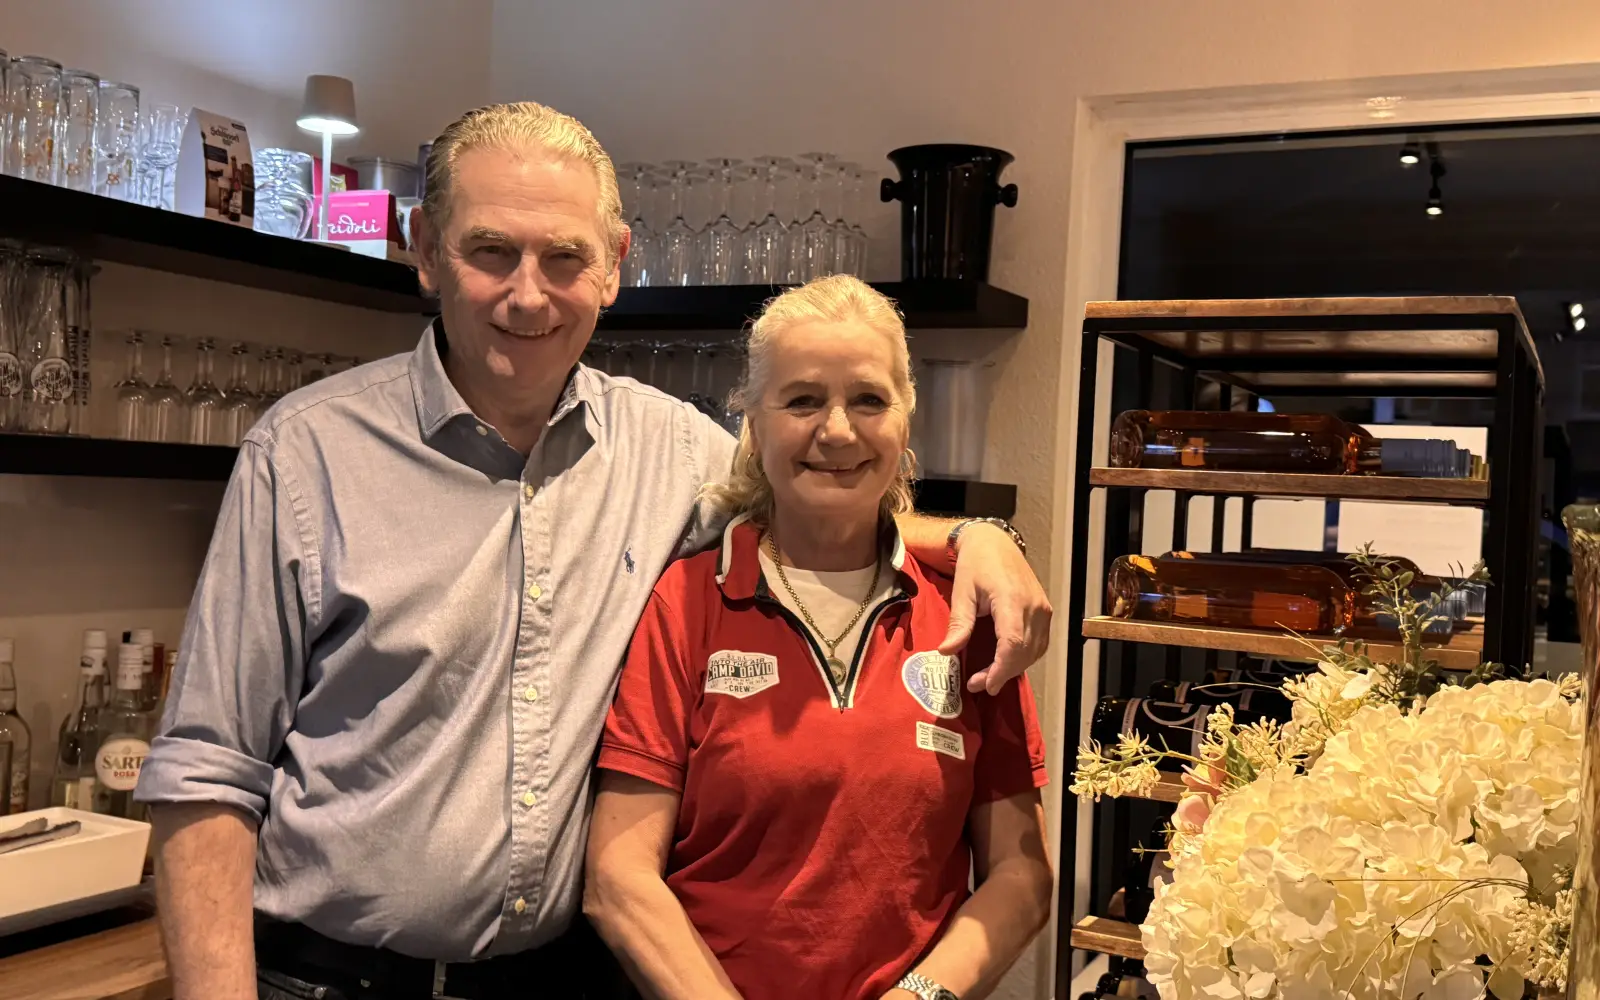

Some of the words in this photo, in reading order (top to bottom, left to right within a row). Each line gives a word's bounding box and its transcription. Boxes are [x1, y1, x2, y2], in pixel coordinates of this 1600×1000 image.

[711, 659, 731, 667] INTO
[739, 662, 773, 678] DAVID
[728, 685, 751, 693] CREW
[920, 672, 955, 692] BLUE
[102, 755, 145, 769] SART
